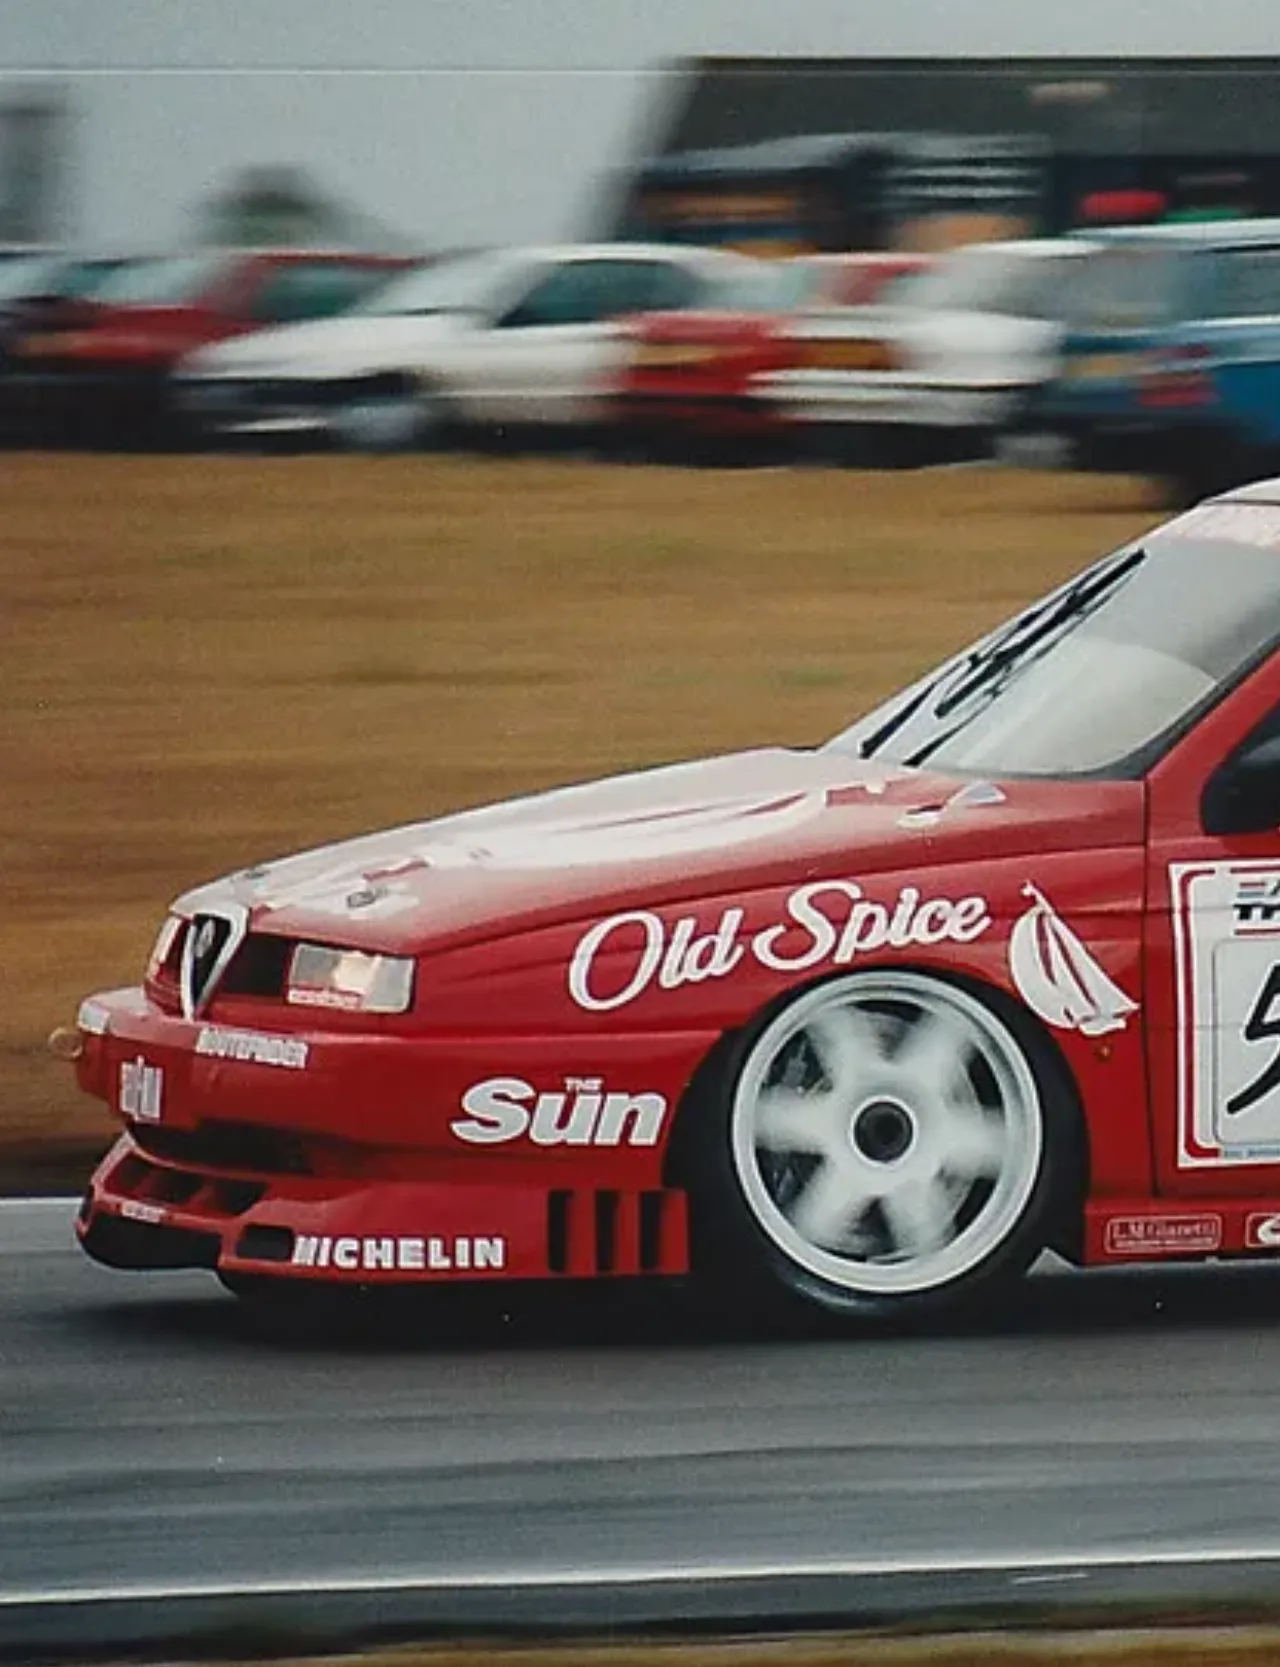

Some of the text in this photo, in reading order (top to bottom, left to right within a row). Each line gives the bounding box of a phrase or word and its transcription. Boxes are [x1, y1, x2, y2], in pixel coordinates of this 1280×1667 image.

[568, 879, 993, 1012] Old Spice
[450, 1076, 668, 1146] Sun
[291, 1235, 505, 1270] MICHELIN
